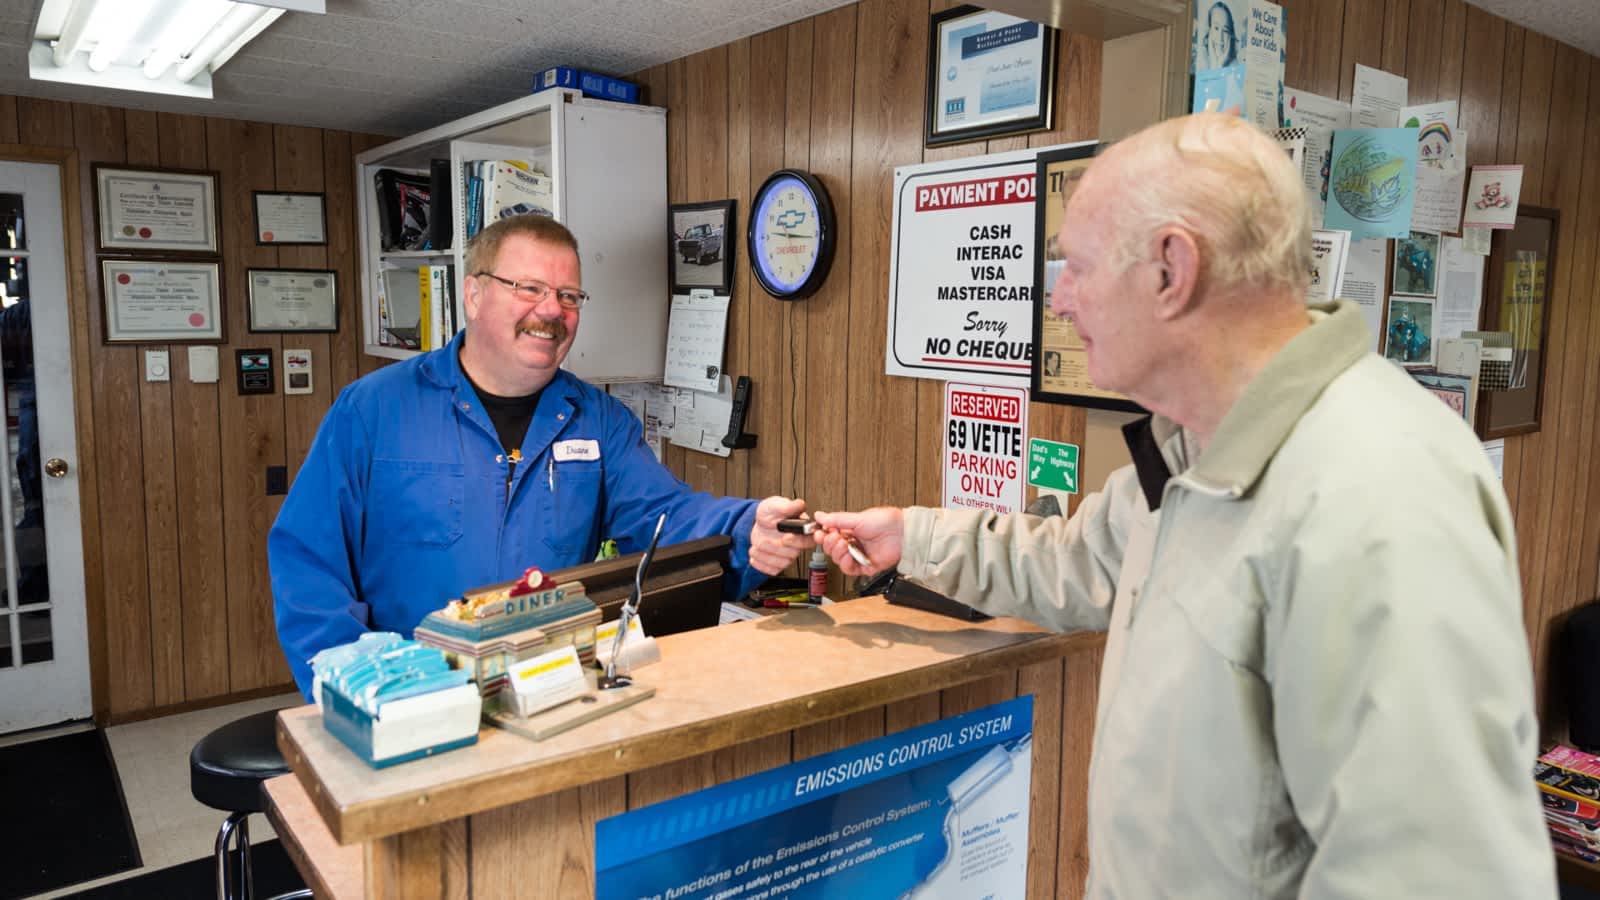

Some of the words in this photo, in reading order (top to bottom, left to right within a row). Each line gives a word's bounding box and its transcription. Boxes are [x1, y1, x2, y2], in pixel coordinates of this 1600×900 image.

[1252, 7, 1262, 18] We
[1263, 11, 1277, 25] Care
[1255, 23, 1274, 37] About
[1263, 39, 1277, 52] Kids
[919, 182, 999, 208] PAYMENT
[970, 224, 1011, 241] CASH
[775, 245, 808, 255] CHEVROLET
[957, 244, 1023, 261] INTERAC
[971, 266, 1006, 281] VISA
[963, 311, 1008, 338] Sorry
[926, 338, 951, 356] NO
[952, 393, 1018, 419] RESERVED
[948, 419, 967, 449] 69
[971, 421, 1021, 458] VETTE
[1032, 443, 1048, 454] Dad's
[1058, 448, 1069, 458] The
[951, 451, 1017, 480] PARKING
[1033, 454, 1045, 464] Way
[1050, 456, 1075, 470] Highway
[961, 474, 1004, 498] ONLY
[952, 495, 964, 505] ALL
[504, 589, 565, 615] DINER
[795, 752, 884, 796] EMISSIONS
[888, 731, 955, 767] CONTROL
[959, 714, 1013, 745] SYSTEM
[665, 869, 732, 900] functions
[735, 860, 750, 876] of
[752, 854, 774, 870] the
[776, 831, 840, 860] Emissions
[842, 812, 885, 837] Control
[887, 799, 932, 822] System:
[745, 873, 773, 890] safely
[773, 869, 784, 880] to
[784, 863, 799, 876] the
[800, 856, 819, 870] rear
[819, 851, 830, 863] of
[830, 847, 844, 859] the
[845, 836, 873, 853] vehicle
[770, 876, 805, 896] through
[806, 871, 820, 883] the
[821, 864, 838, 877] use
[838, 858, 849, 871] of
[855, 844, 887, 866] catalytic
[888, 832, 925, 852] converter
